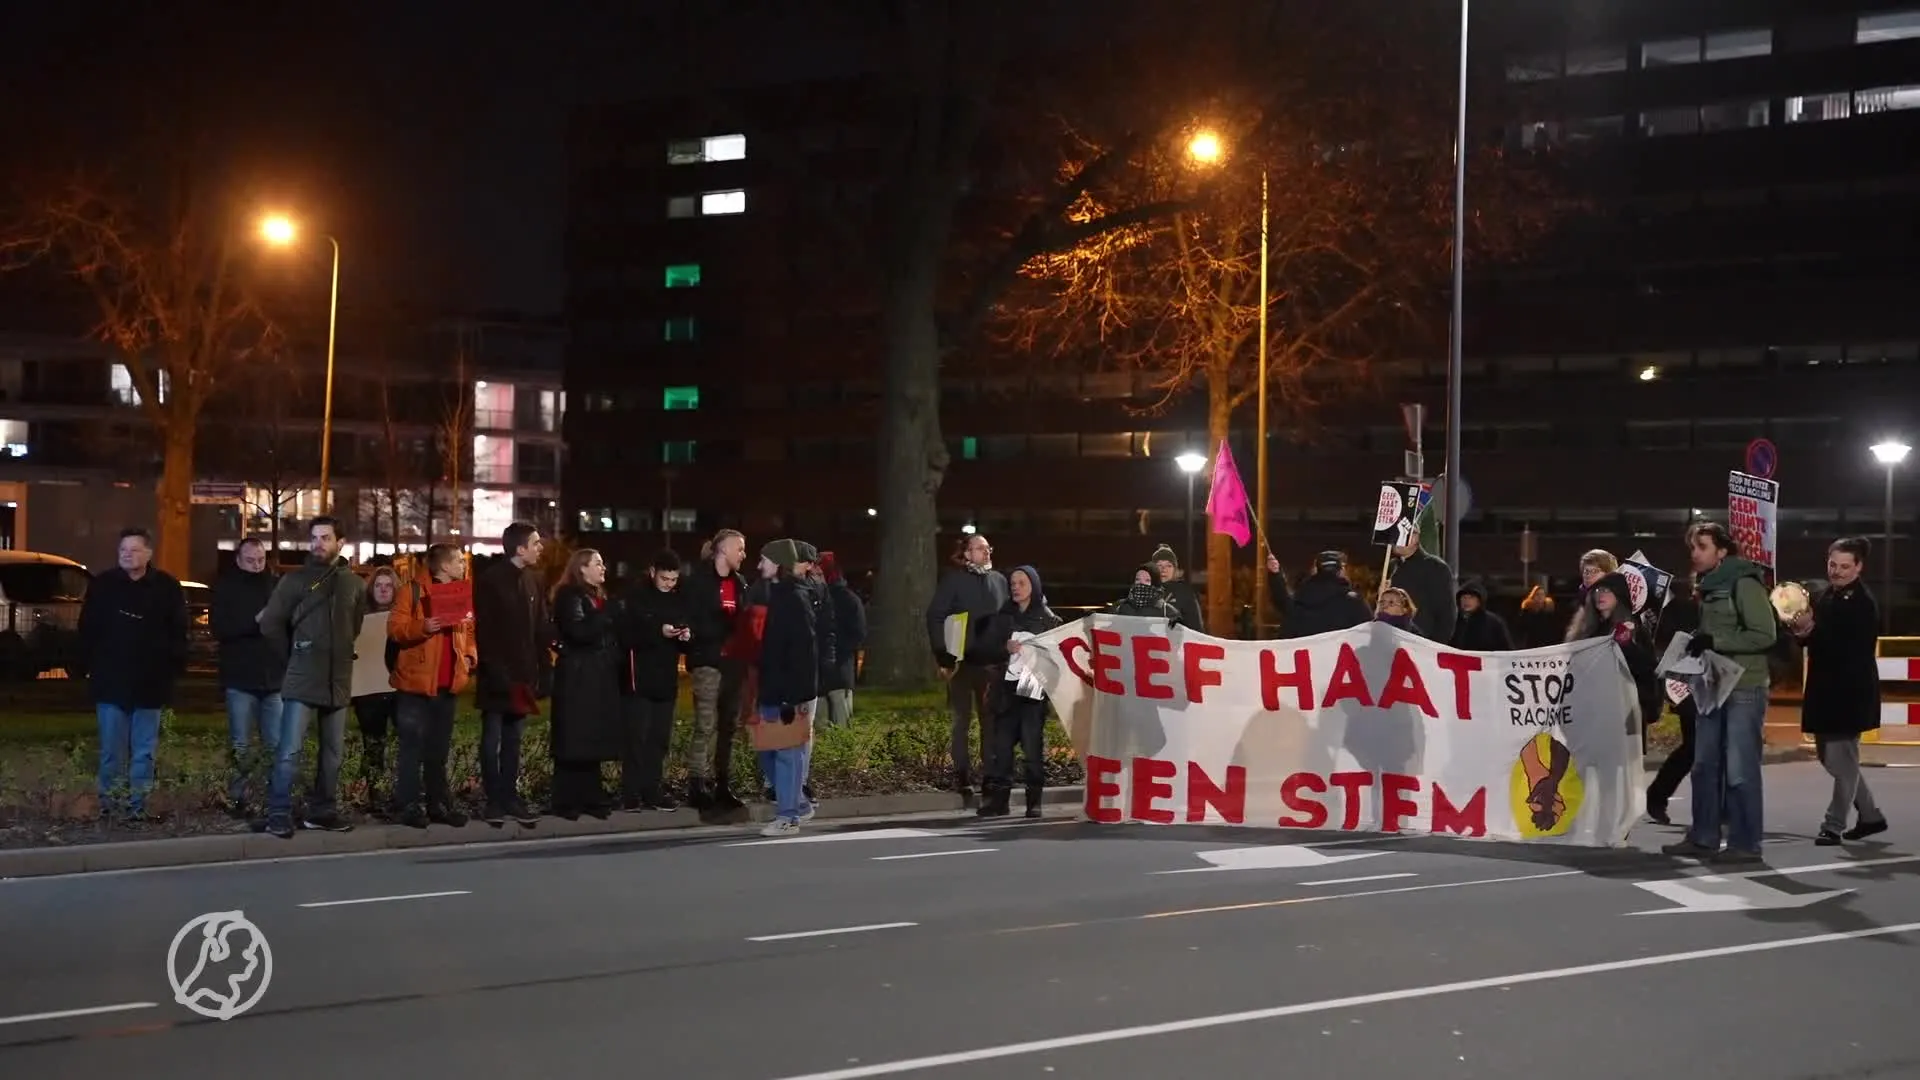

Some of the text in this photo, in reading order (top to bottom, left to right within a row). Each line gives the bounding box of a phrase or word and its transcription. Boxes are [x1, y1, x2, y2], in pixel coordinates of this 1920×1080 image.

[1730, 496, 1757, 514] GEEN
[1259, 643, 1483, 720] HAAT
[1505, 673, 1574, 705] STOP
[1085, 755, 1246, 825] EEN
